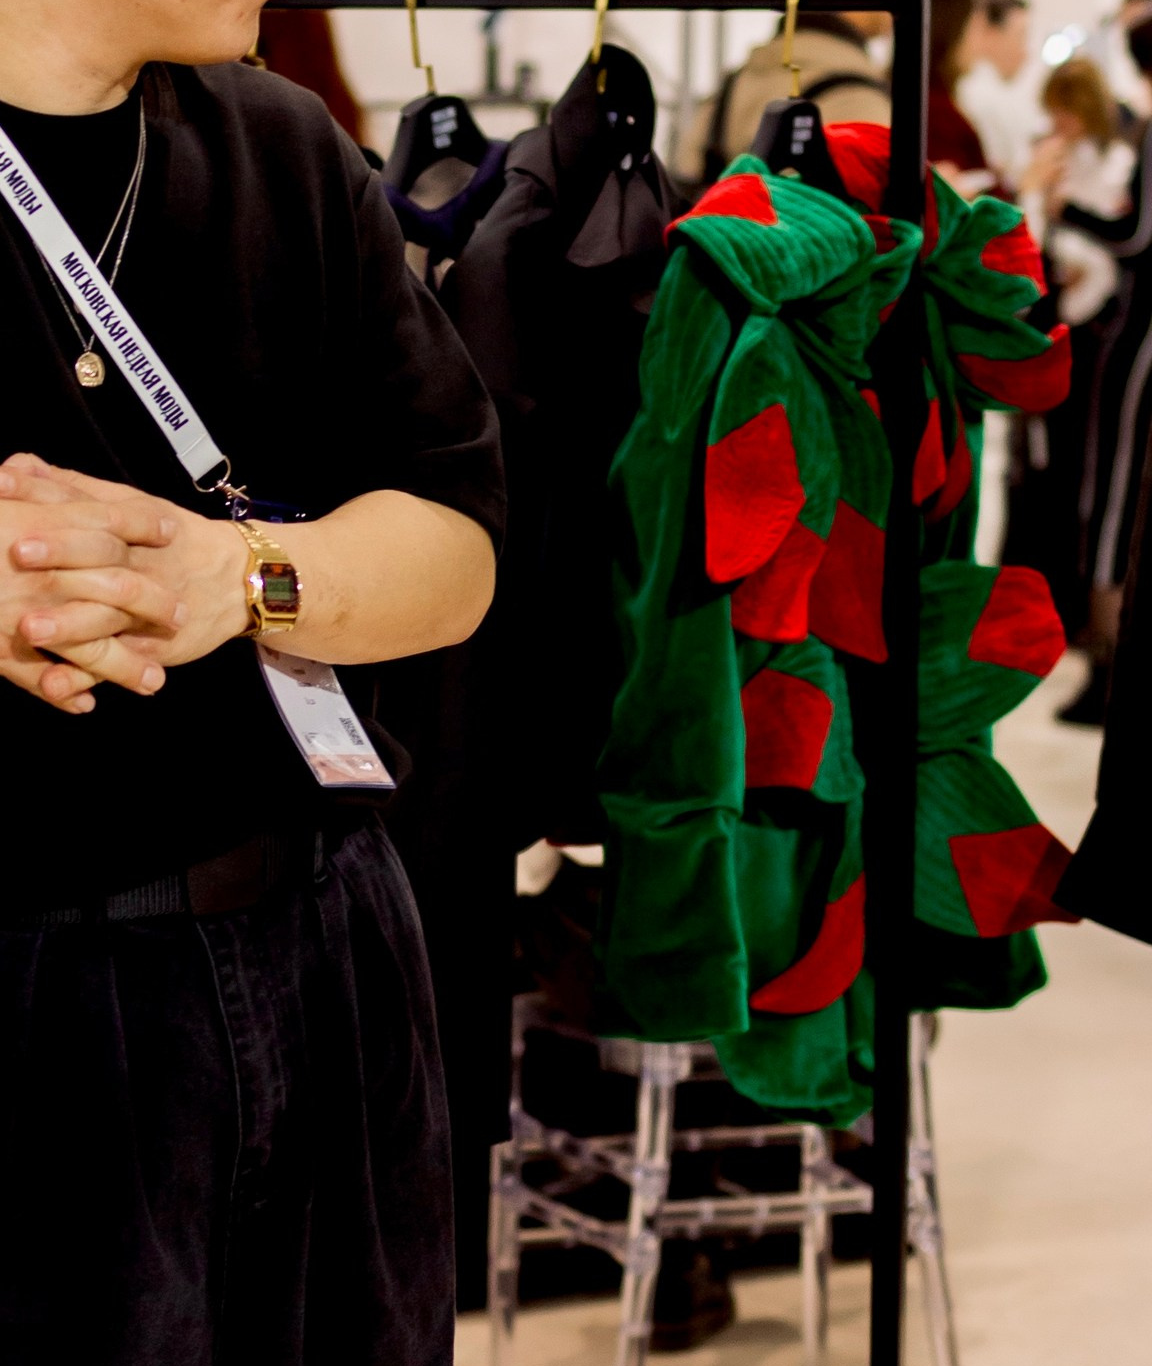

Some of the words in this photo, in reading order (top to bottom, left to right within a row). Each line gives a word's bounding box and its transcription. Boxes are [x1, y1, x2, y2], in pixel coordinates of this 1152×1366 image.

[5, 168, 43, 215] МОДЫ
[61, 251, 128, 342] МОСКОВСКАЯ
[119, 337, 160, 390] НЕДЕЛЯ
[151, 385, 189, 431] МОДЫ
